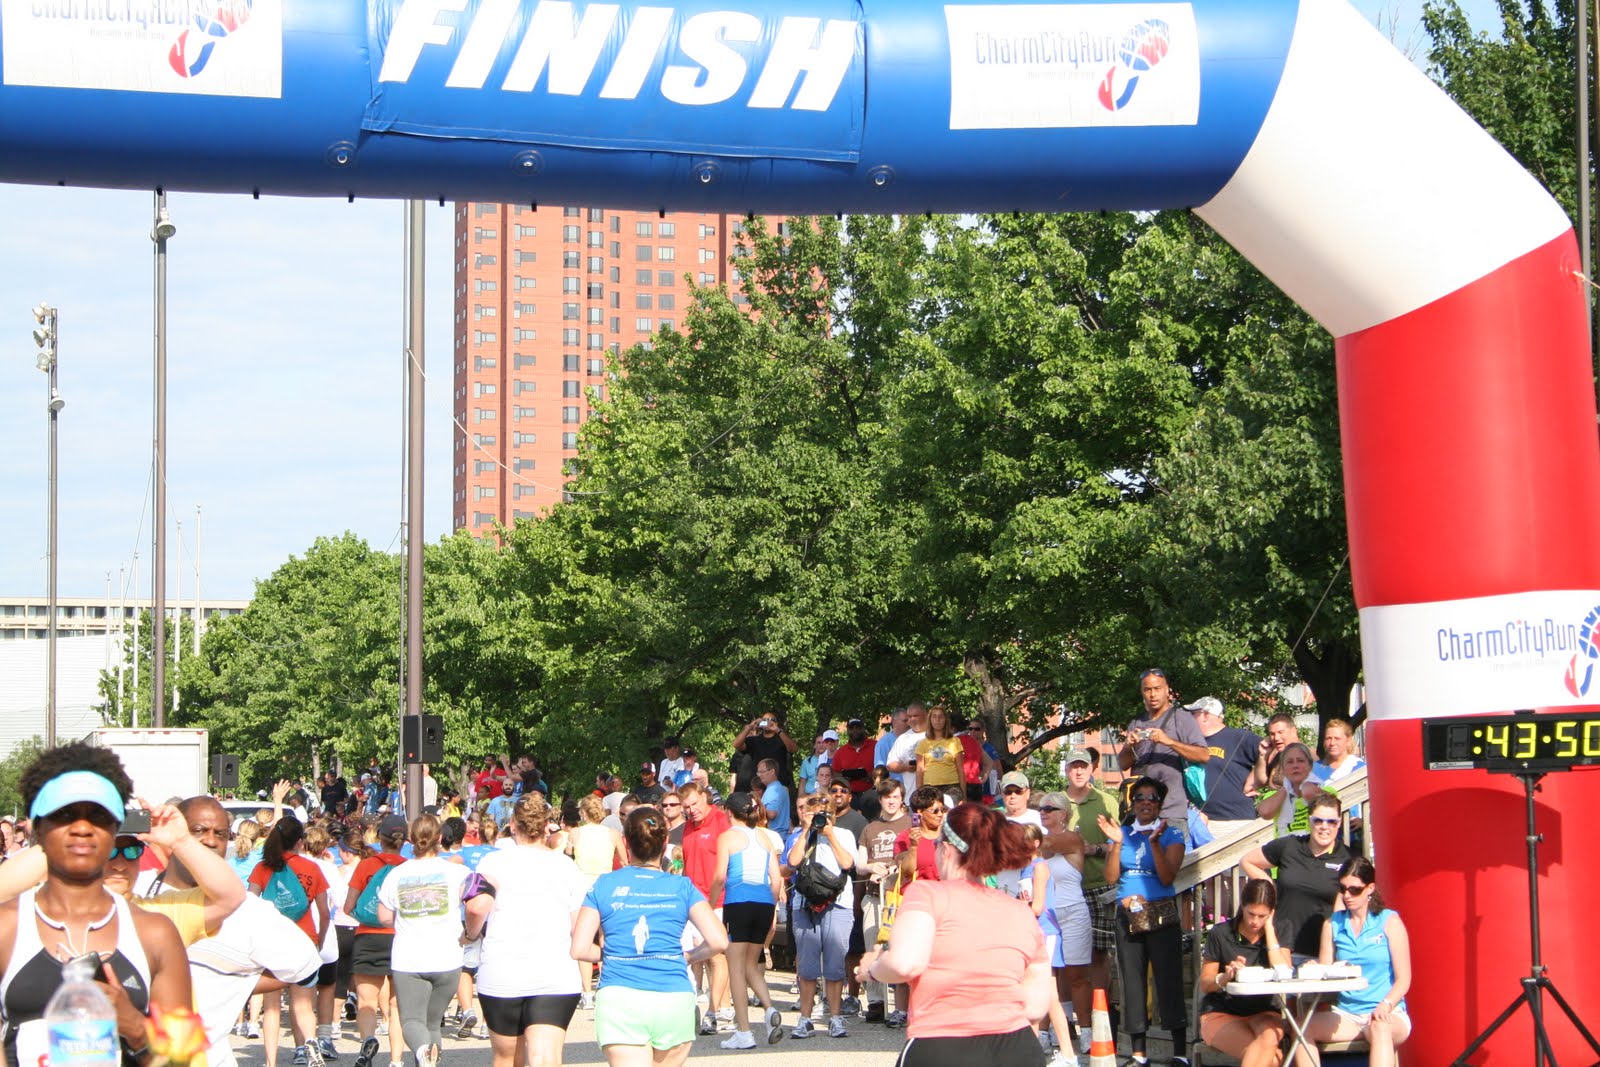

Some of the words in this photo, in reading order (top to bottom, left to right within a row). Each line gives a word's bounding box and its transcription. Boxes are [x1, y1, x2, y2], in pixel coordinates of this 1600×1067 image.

[378, 0, 856, 112] FINISH
[975, 31, 1116, 69] CharmCityRun
[1437, 618, 1577, 661] CharmCityRun
